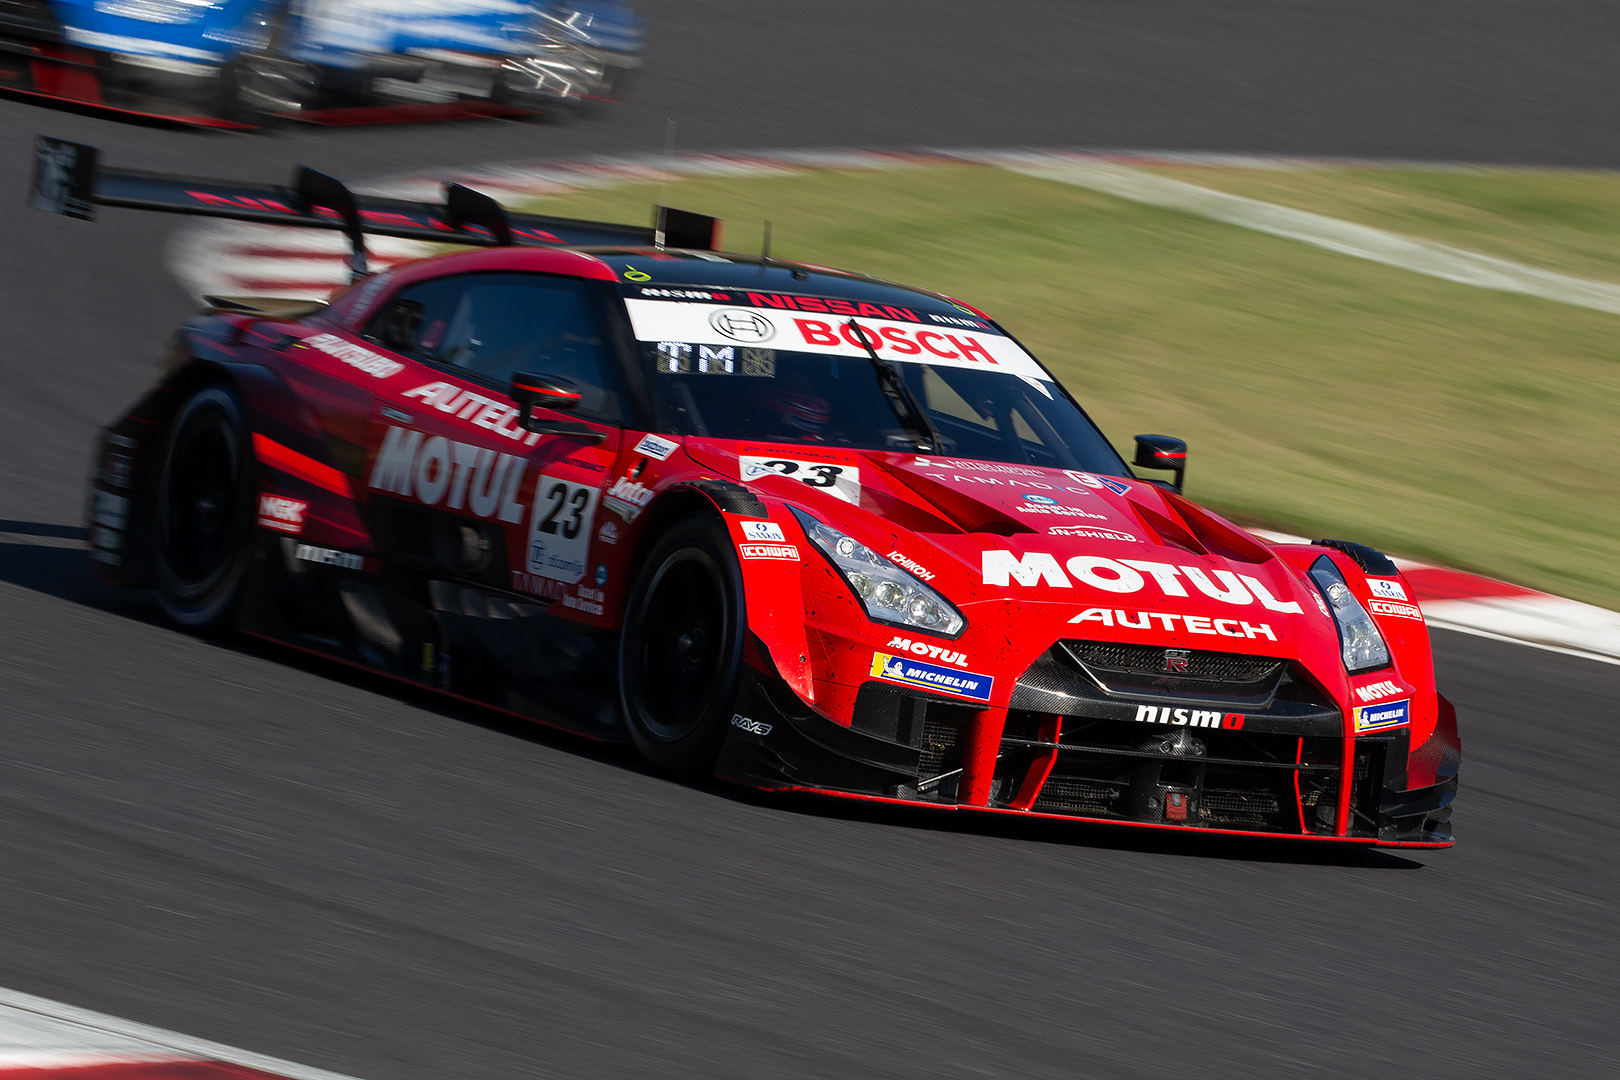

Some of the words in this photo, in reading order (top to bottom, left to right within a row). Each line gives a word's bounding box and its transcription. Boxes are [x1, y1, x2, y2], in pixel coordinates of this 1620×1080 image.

[746, 291, 922, 323] NISSAN
[929, 313, 991, 330] nismo
[791, 317, 1000, 365] BOSCH
[367, 425, 528, 524] MOTUL
[925, 473, 1090, 495] TAMADIC
[259, 495, 306, 521] NGK
[538, 483, 590, 540] 23
[1048, 527, 1137, 542] JN-SHIELD
[886, 551, 936, 581] ICHIKOH
[982, 550, 1304, 614] MOTUL
[1067, 608, 1278, 641] AUTECH
[887, 636, 969, 668] MOTUL
[905, 667, 979, 691] MICHELIN
[1355, 680, 1404, 702] MOTUL
[731, 713, 773, 736] RAYS
[1135, 705, 1245, 730] nismo
[1369, 708, 1405, 722] MICHELIN
